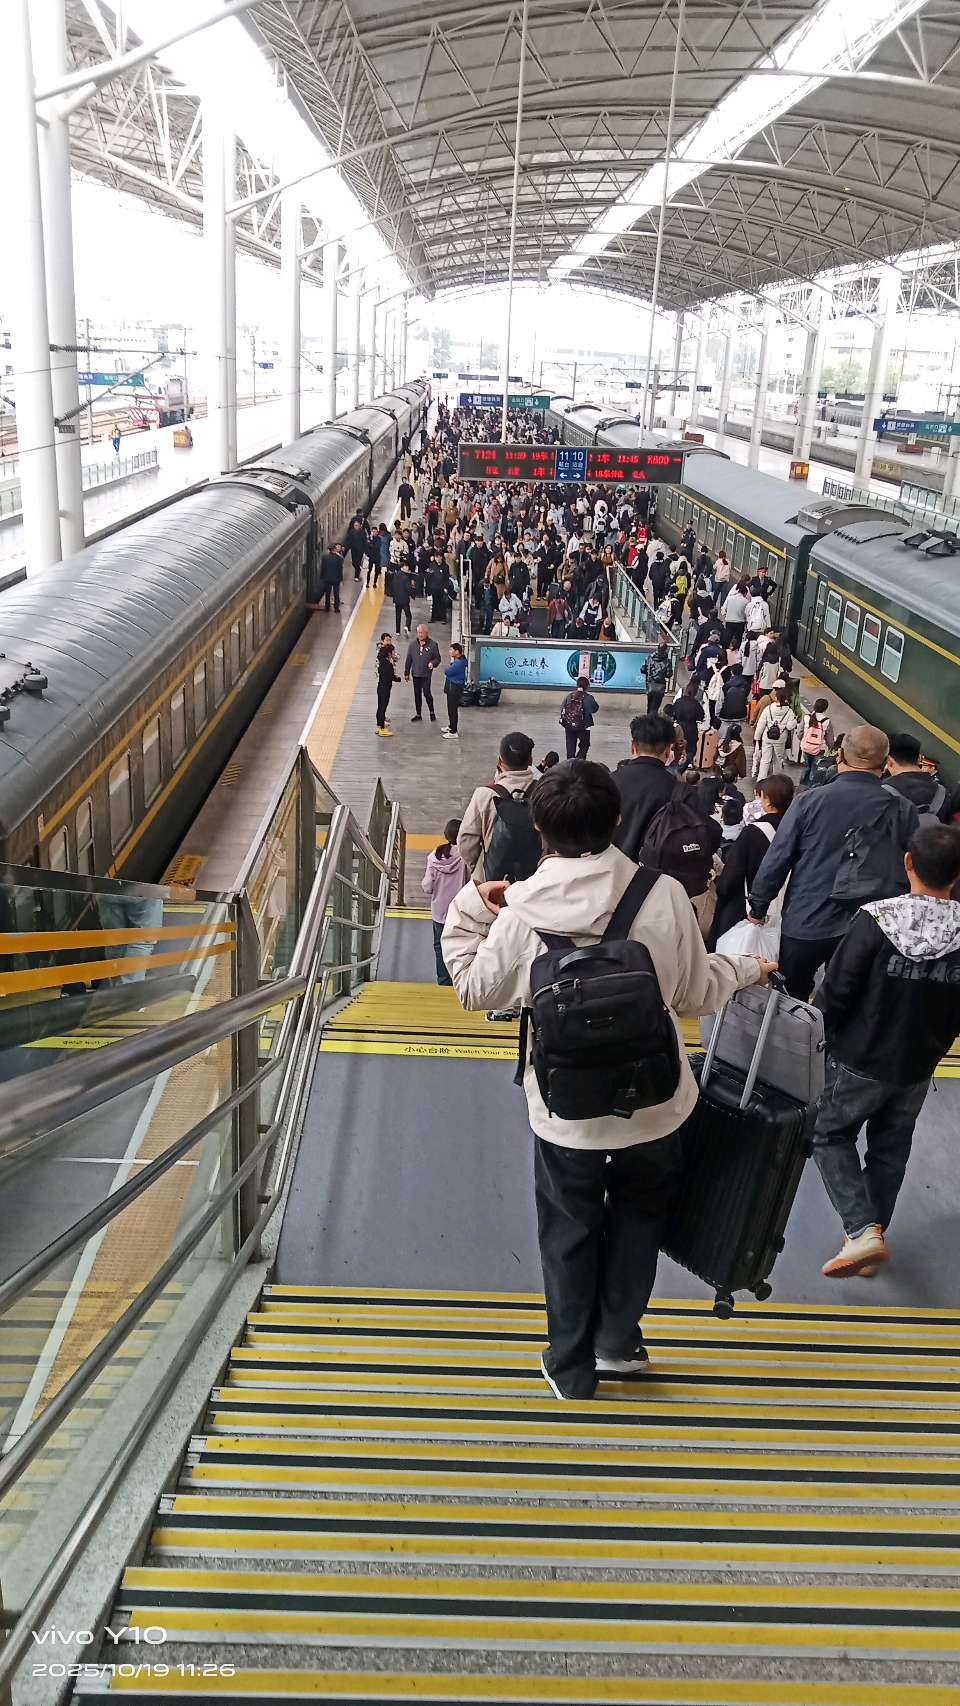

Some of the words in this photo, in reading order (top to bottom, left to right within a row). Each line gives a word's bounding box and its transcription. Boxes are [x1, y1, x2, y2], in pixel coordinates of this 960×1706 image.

[559, 451, 569, 461] 11
[573, 451, 584, 461] 10
[404, 1046, 450, 1055] 小心台阶
